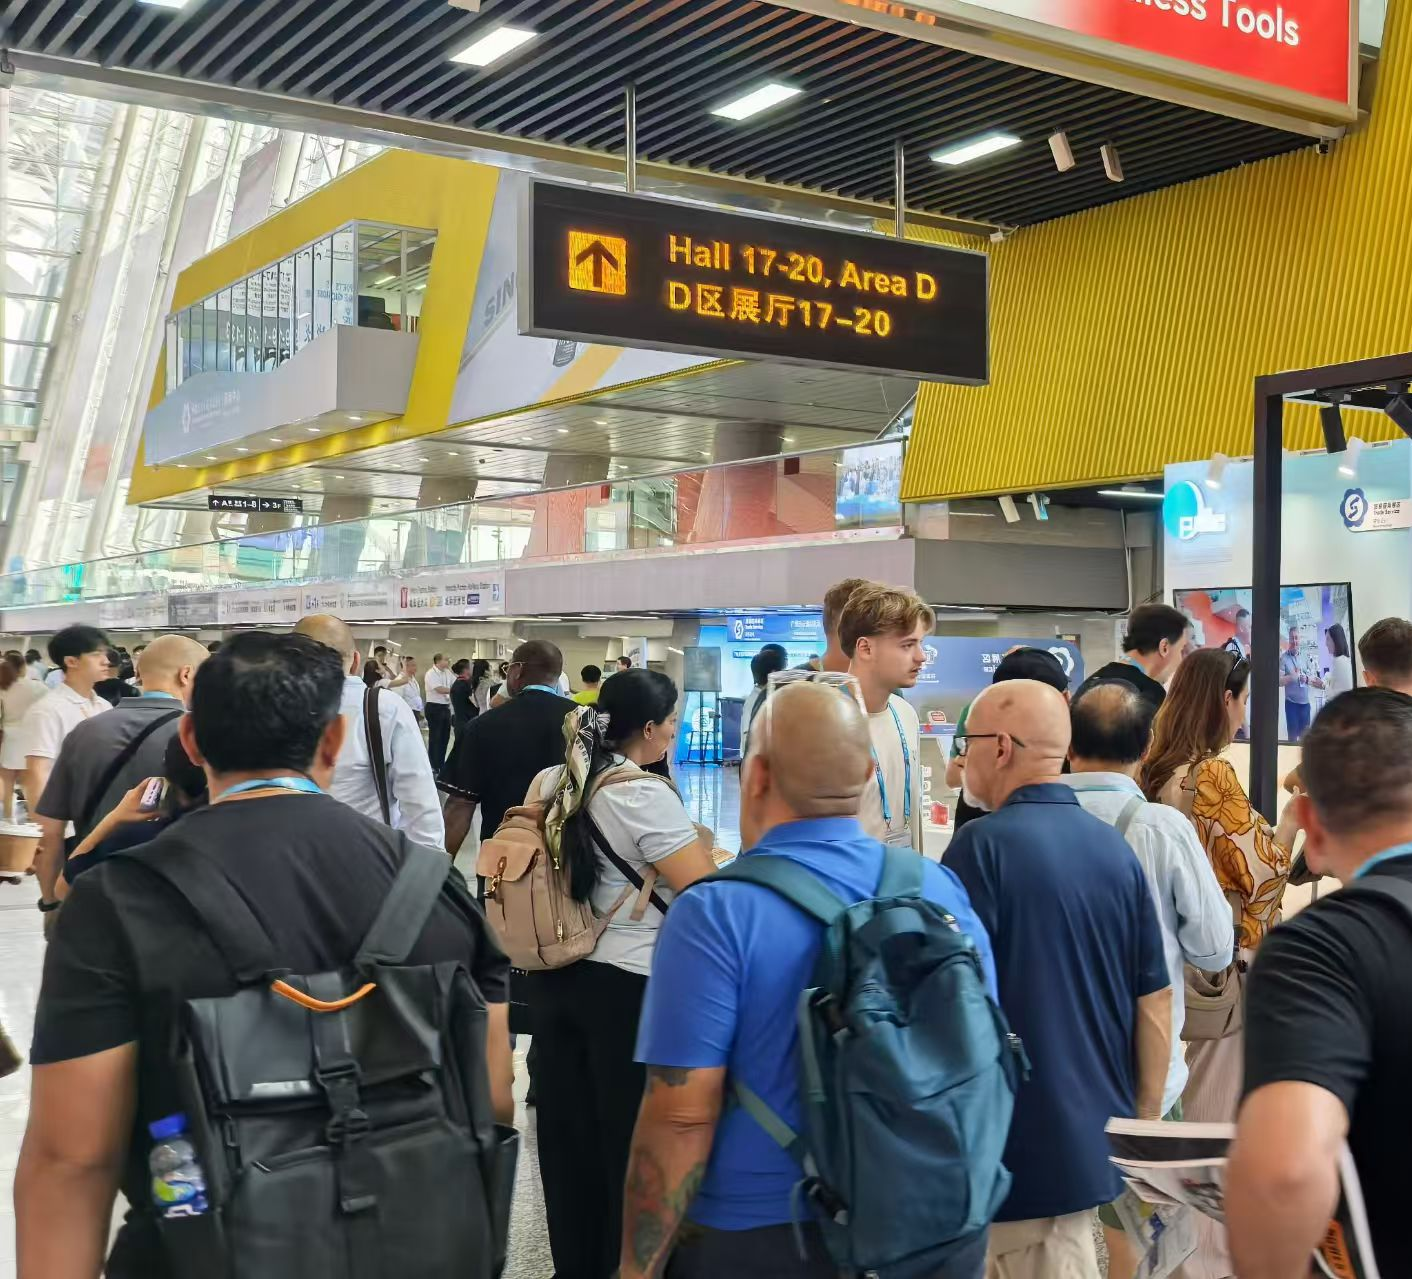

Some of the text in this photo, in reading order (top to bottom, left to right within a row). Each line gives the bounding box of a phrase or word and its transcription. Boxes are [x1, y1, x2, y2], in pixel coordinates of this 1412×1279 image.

[1221, 0, 1300, 46] Tools
[667, 233, 937, 300] Hall 17-20, Area D
[668, 280, 891, 338] D区展厅17-20
